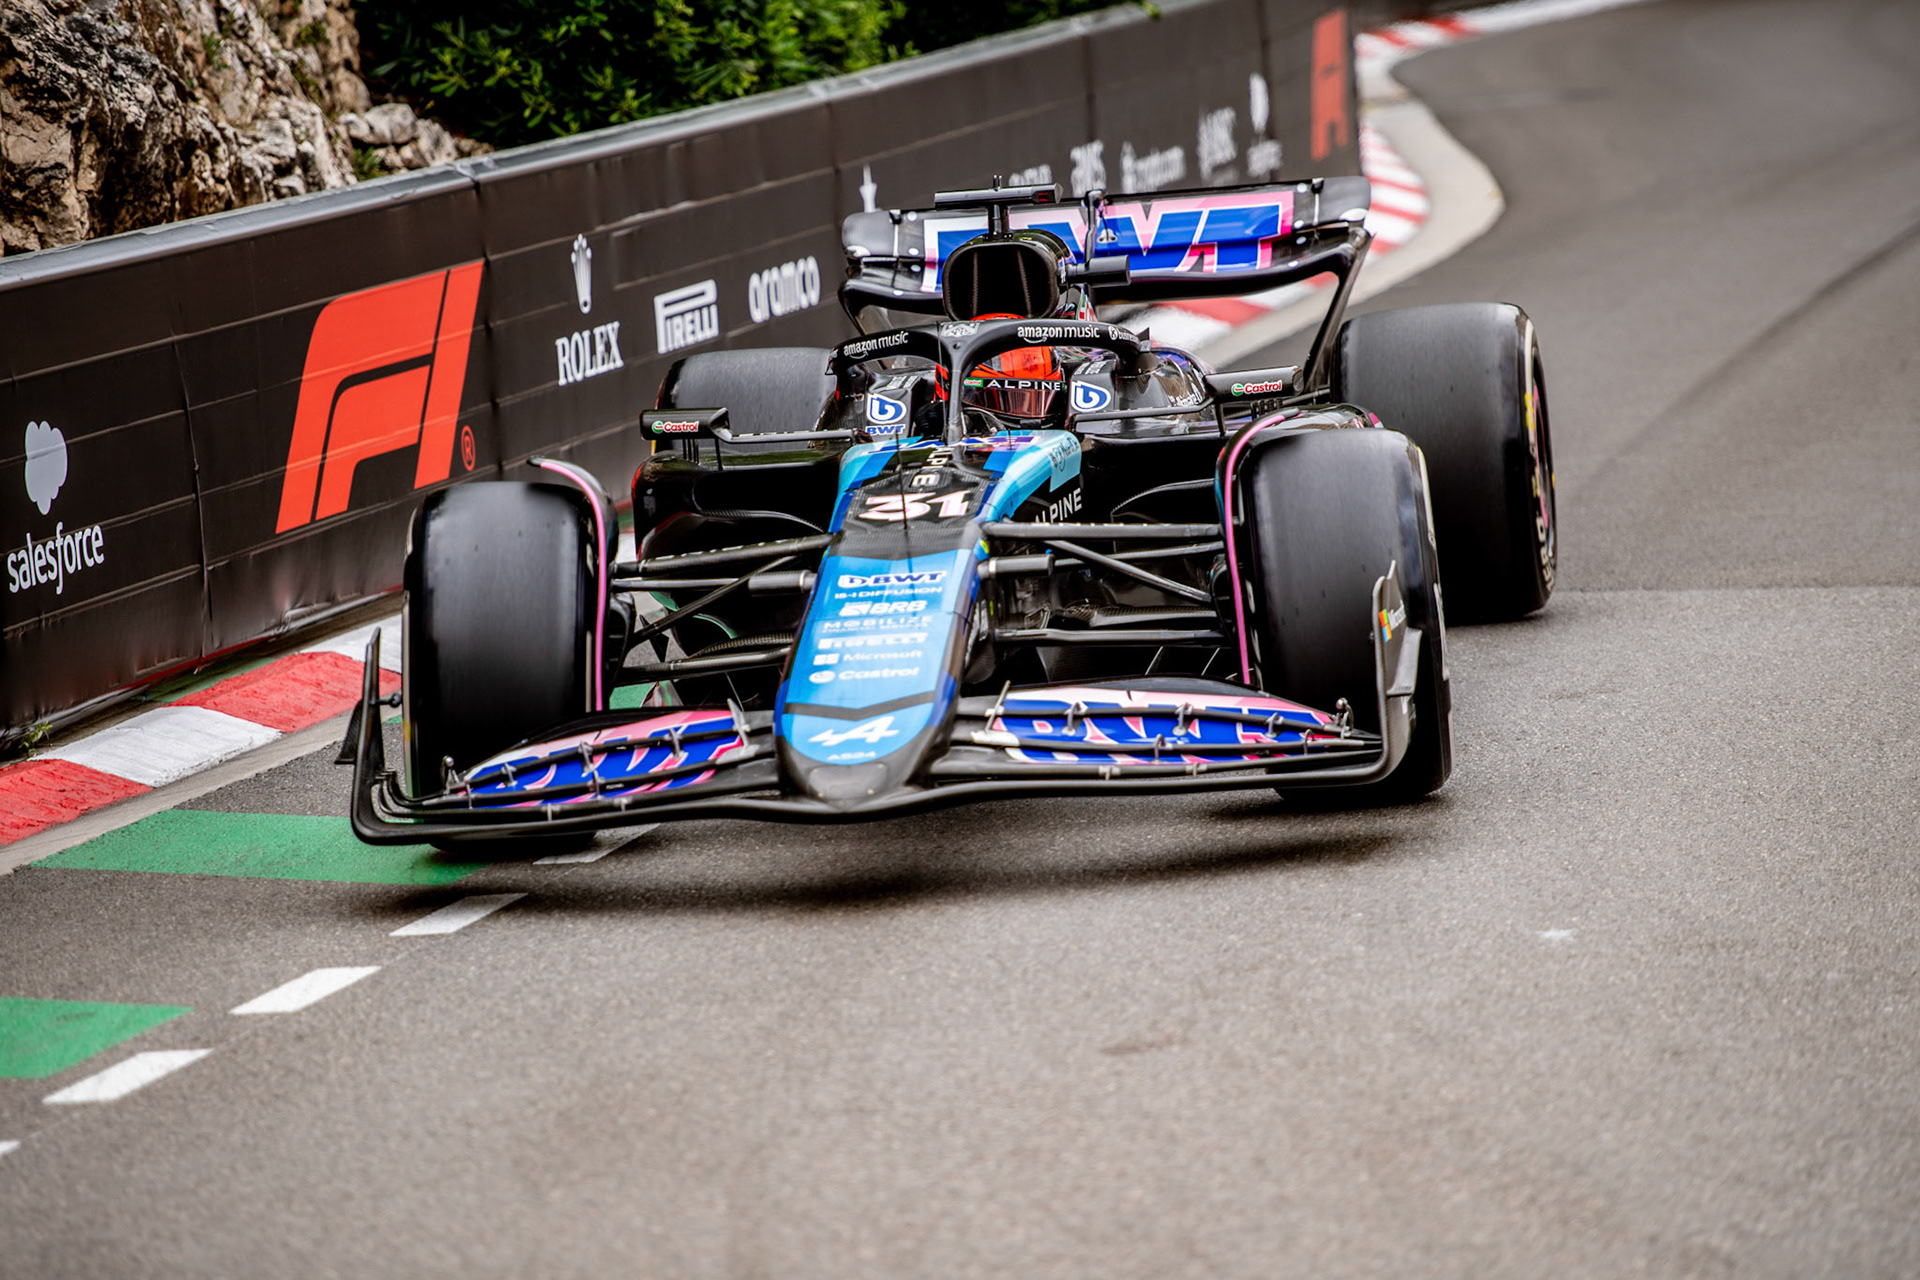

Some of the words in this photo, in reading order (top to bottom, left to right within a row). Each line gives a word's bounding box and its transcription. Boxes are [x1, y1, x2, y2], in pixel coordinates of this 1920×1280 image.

[748, 256, 820, 323] aramco
[654, 279, 719, 354] PIRELLI
[1017, 326, 1062, 339] amazon
[1064, 324, 1100, 338] music
[843, 339, 878, 357] amazon
[878, 331, 909, 349] music
[555, 321, 624, 386] ROLEX
[987, 379, 1061, 391] ALPINE
[1244, 380, 1283, 394] Castrol
[663, 421, 699, 433] Castrol
[865, 424, 905, 435] BWT
[858, 489, 971, 522] 31
[7, 521, 105, 595] salesforce
[870, 571, 946, 587] BWT
[843, 650, 922, 662] Microsoft
[838, 667, 920, 680] Castrol
